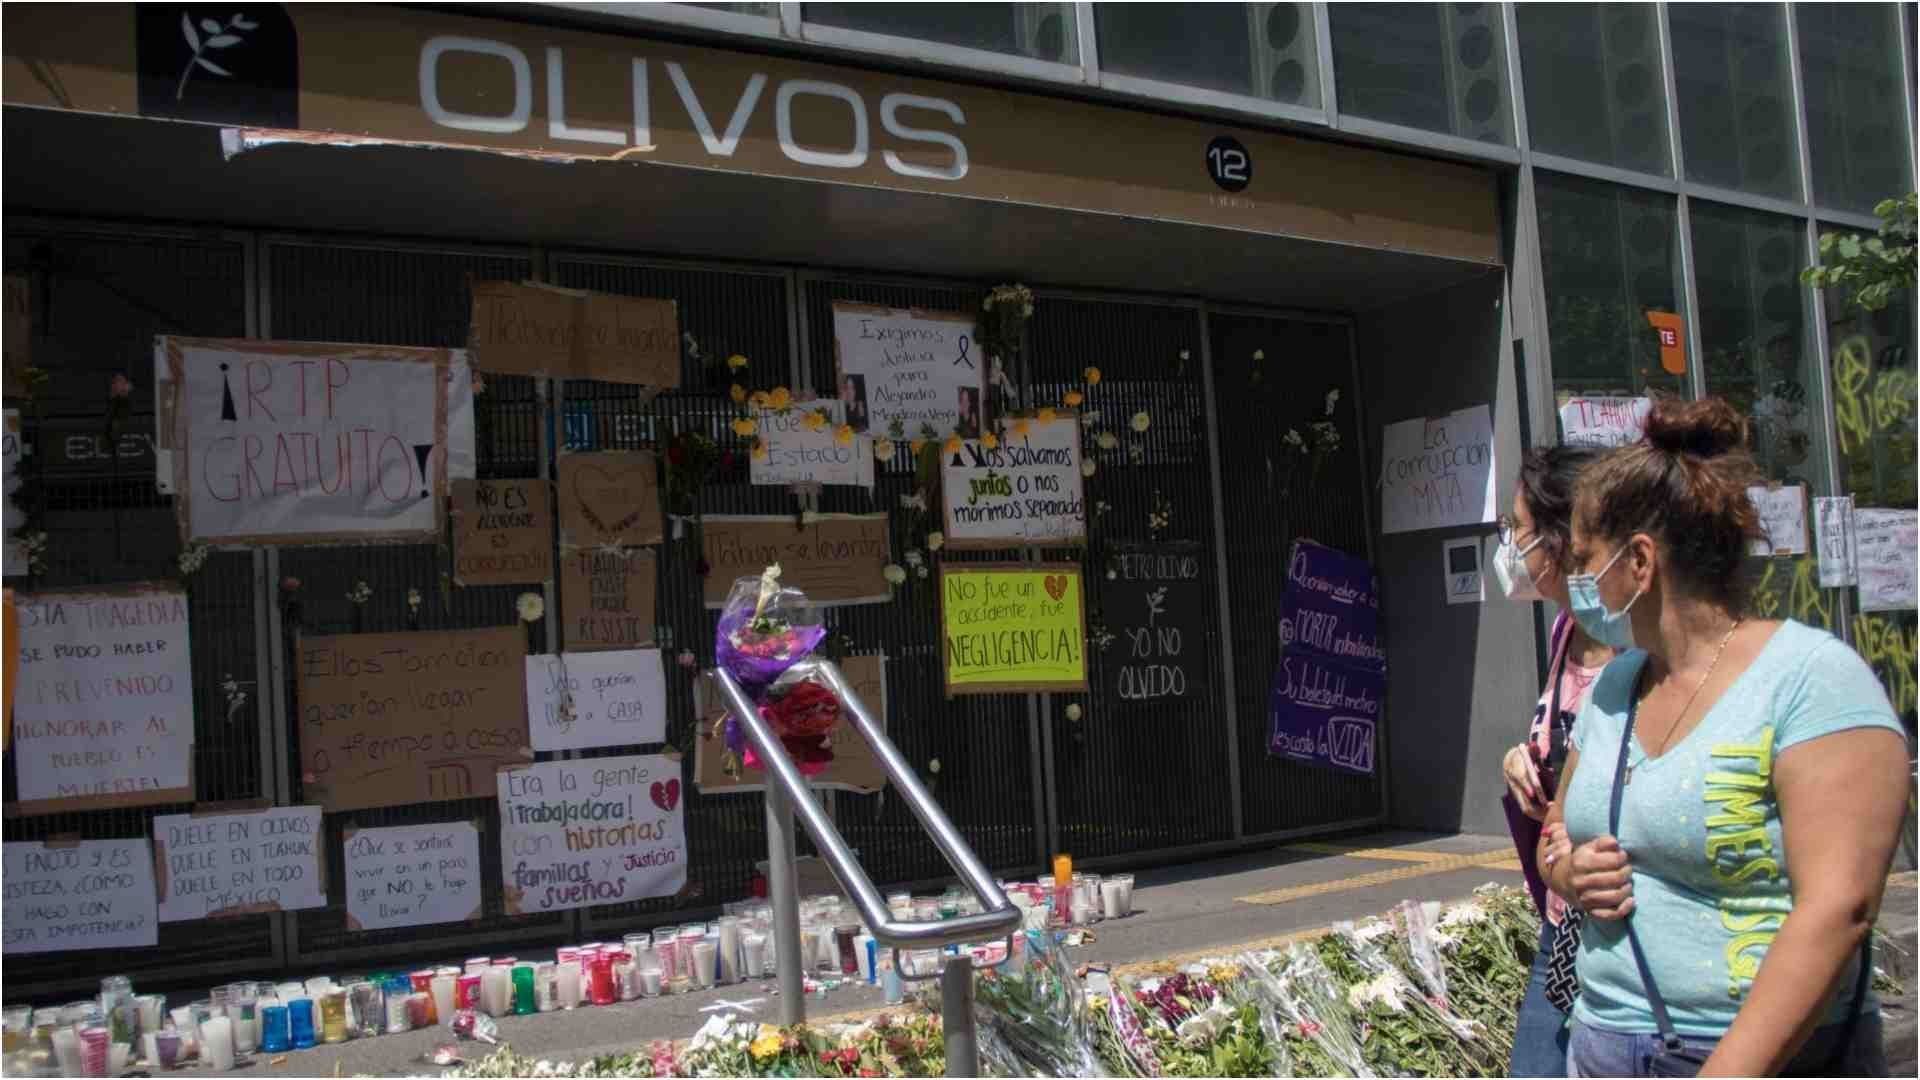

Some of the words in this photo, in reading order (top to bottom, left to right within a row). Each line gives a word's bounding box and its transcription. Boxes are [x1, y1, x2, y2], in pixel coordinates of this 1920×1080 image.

[418, 35, 969, 181] OLIVOS
[1208, 147, 1248, 181] 12
[889, 370, 929, 387] para
[1005, 434, 1073, 467] salvamos
[1424, 426, 1448, 449] La
[203, 426, 434, 503] GRATUITO!
[475, 481, 498, 507] NO
[504, 486, 528, 510] ES
[968, 469, 1013, 506] juntas
[1034, 474, 1060, 492] nos
[954, 501, 1022, 524] morimos
[947, 578, 976, 603] No
[983, 573, 1009, 606] fue
[1016, 581, 1036, 598] un
[1040, 600, 1065, 617] fue
[53, 643, 101, 660] PUDO
[112, 639, 168, 656] HABER
[946, 626, 1080, 669] NEGLIGENCIA!
[1125, 626, 1151, 657] YO
[1158, 626, 1182, 657] NO
[1117, 664, 1185, 699] OLVIDO
[607, 700, 644, 722] CASA
[1330, 720, 1374, 771] VIDA
[507, 772, 545, 798] Era
[558, 768, 578, 793] la
[591, 764, 650, 797] gente
[506, 793, 634, 827] ¡trabajadora!
[1703, 724, 1779, 884] TIMES
[168, 823, 217, 848] DUELE
[228, 821, 249, 843] EN
[512, 833, 553, 857] con
[564, 818, 667, 852] historias
[170, 851, 217, 875] DUELE
[231, 847, 251, 866] EN
[416, 859, 433, 874] un
[512, 860, 593, 891] familias
[174, 876, 218, 897] DUELE
[231, 870, 254, 888] EN
[264, 864, 304, 883] TODO
[539, 875, 627, 910] sueños
[24, 903, 71, 921] HAGO
[79, 901, 113, 918] CON
